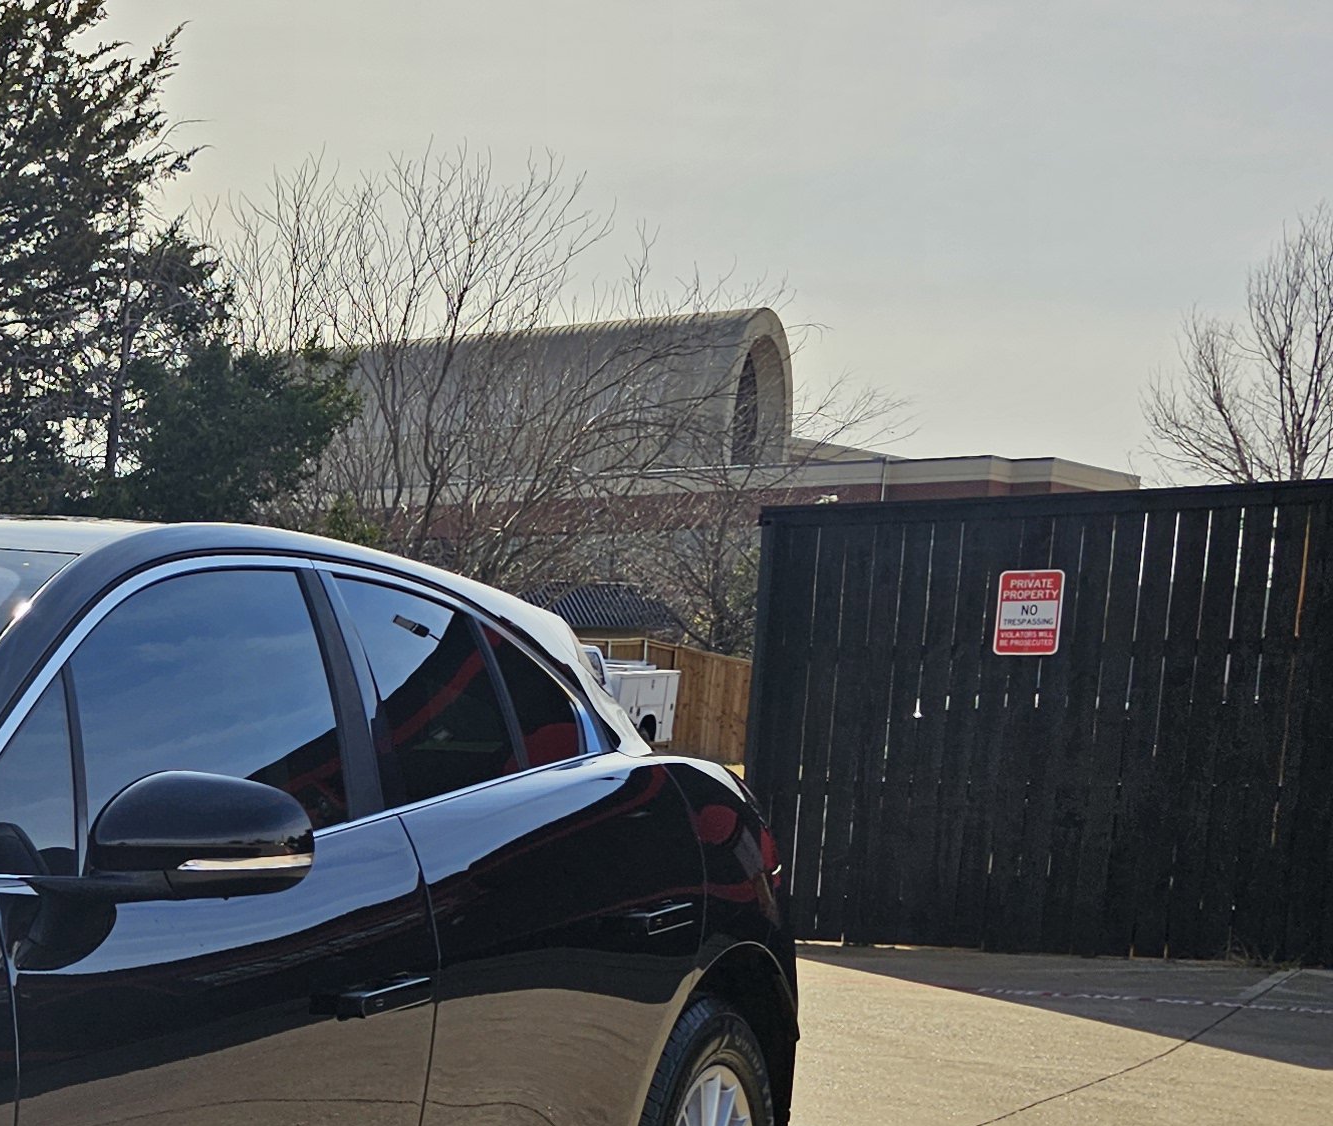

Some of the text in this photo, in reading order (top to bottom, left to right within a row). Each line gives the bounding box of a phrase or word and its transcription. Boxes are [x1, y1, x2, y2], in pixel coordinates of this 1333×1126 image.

[1010, 578, 1054, 589] PRIVATE
[1002, 589, 1059, 600] PROPERTY
[1021, 604, 1038, 616] NO
[1003, 618, 1054, 626] TRESPASSING
